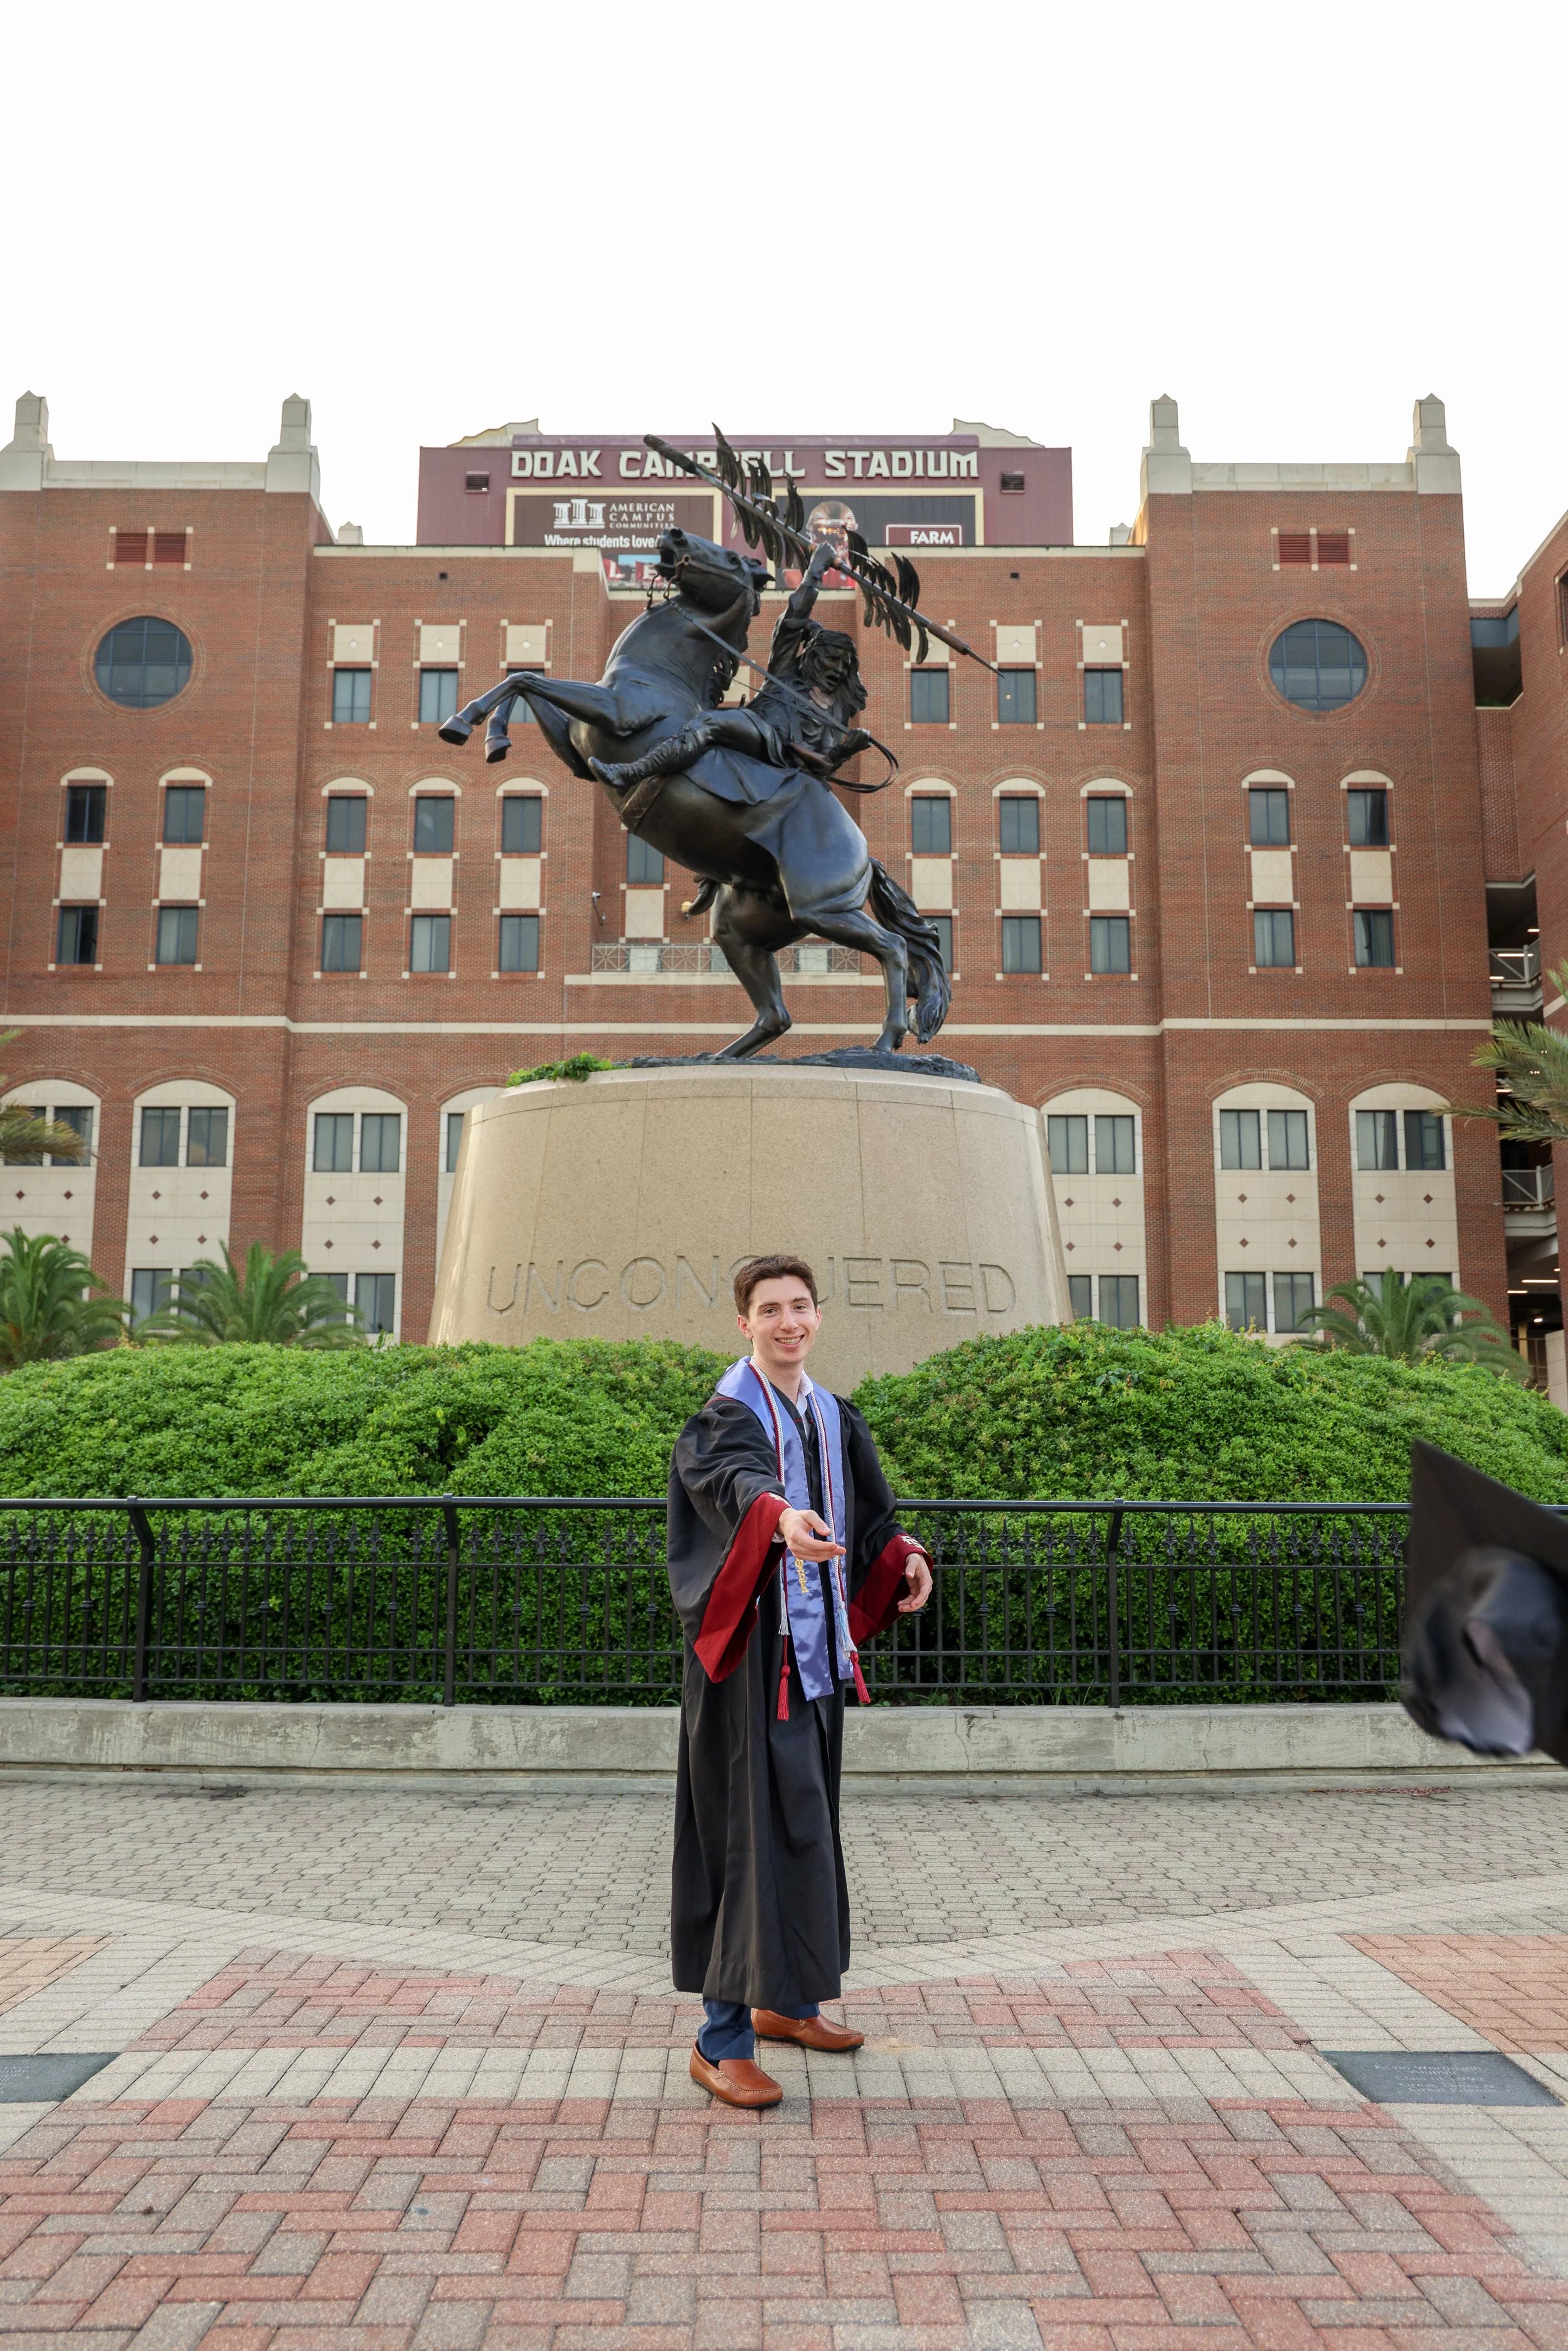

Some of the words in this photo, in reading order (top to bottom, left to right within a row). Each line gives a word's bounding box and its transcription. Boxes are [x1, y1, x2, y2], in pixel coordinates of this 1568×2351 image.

[511, 450, 602, 478] DOAK
[825, 450, 979, 478] STADIUM
[609, 502, 675, 512] AMERICAN
[609, 512, 675, 522] CAMPUS
[544, 534, 581, 546] Where
[583, 534, 630, 548] students
[632, 534, 655, 548] love
[910, 530, 955, 544] FARM
